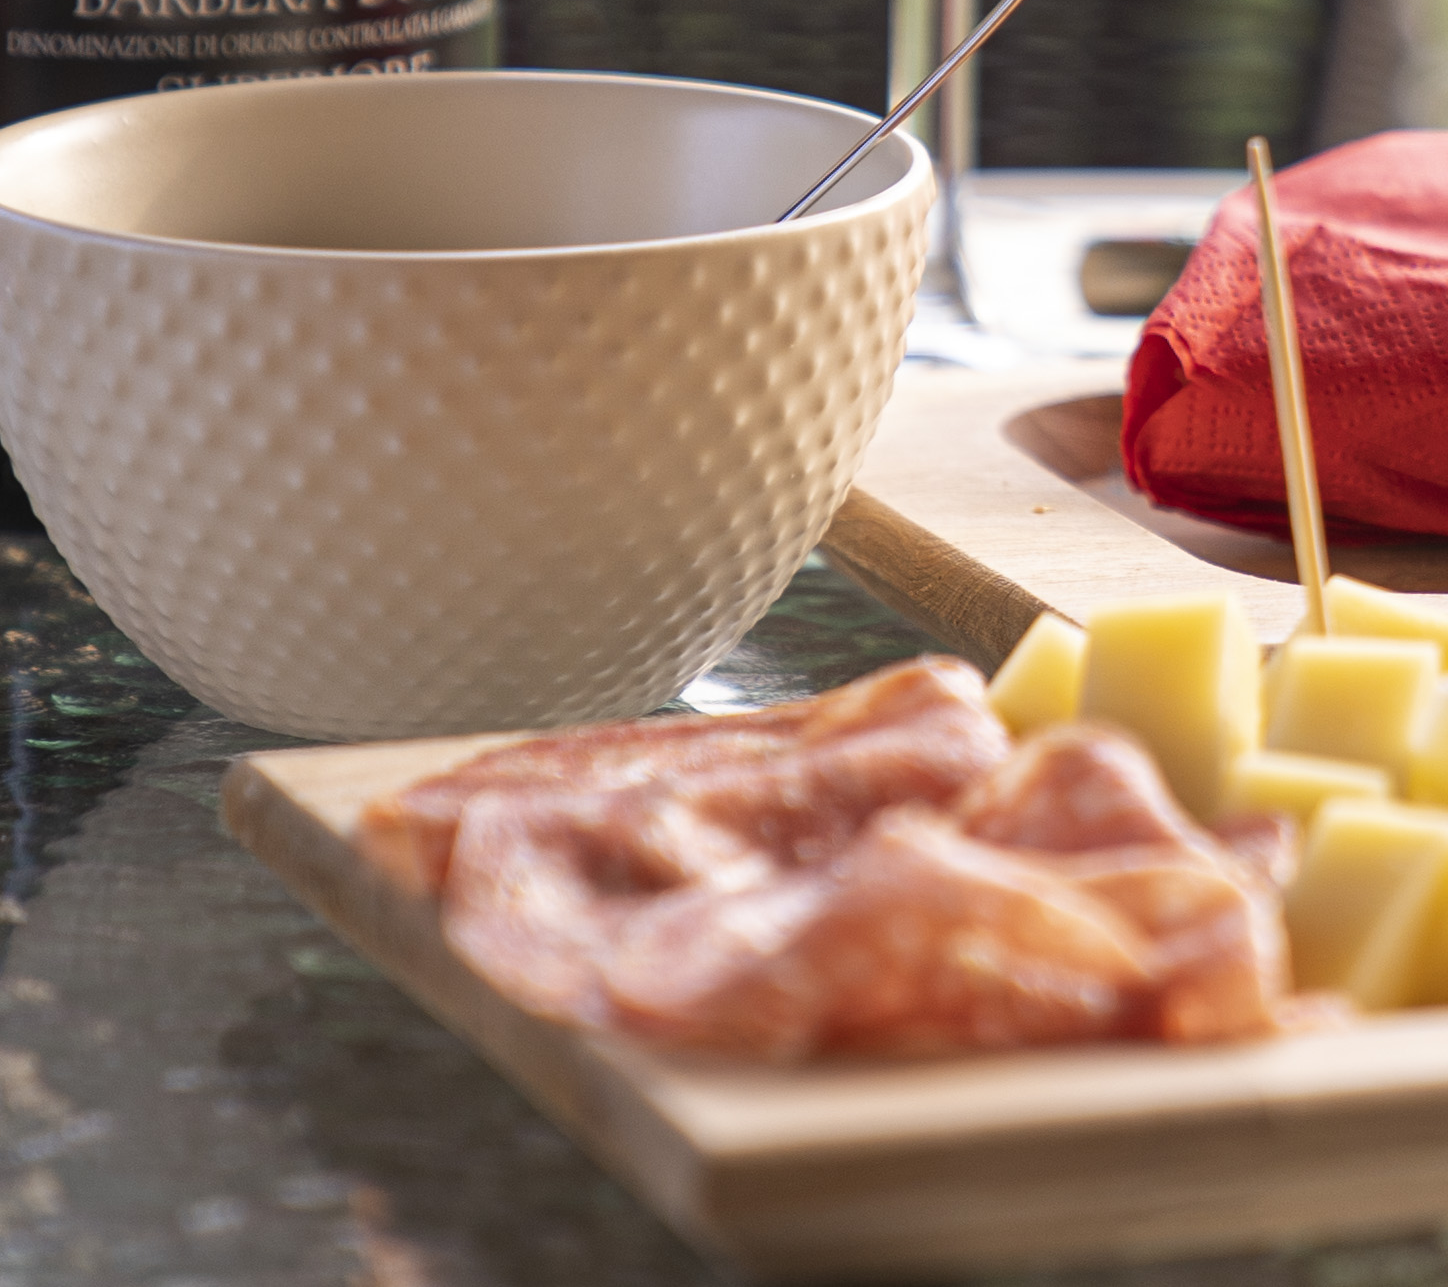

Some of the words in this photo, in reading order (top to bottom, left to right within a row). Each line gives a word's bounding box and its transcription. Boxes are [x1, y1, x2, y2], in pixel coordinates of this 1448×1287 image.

[6, 29, 190, 59] DENOMINAZIONE
[194, 32, 219, 59] DI
[220, 28, 307, 58] ORIGINE
